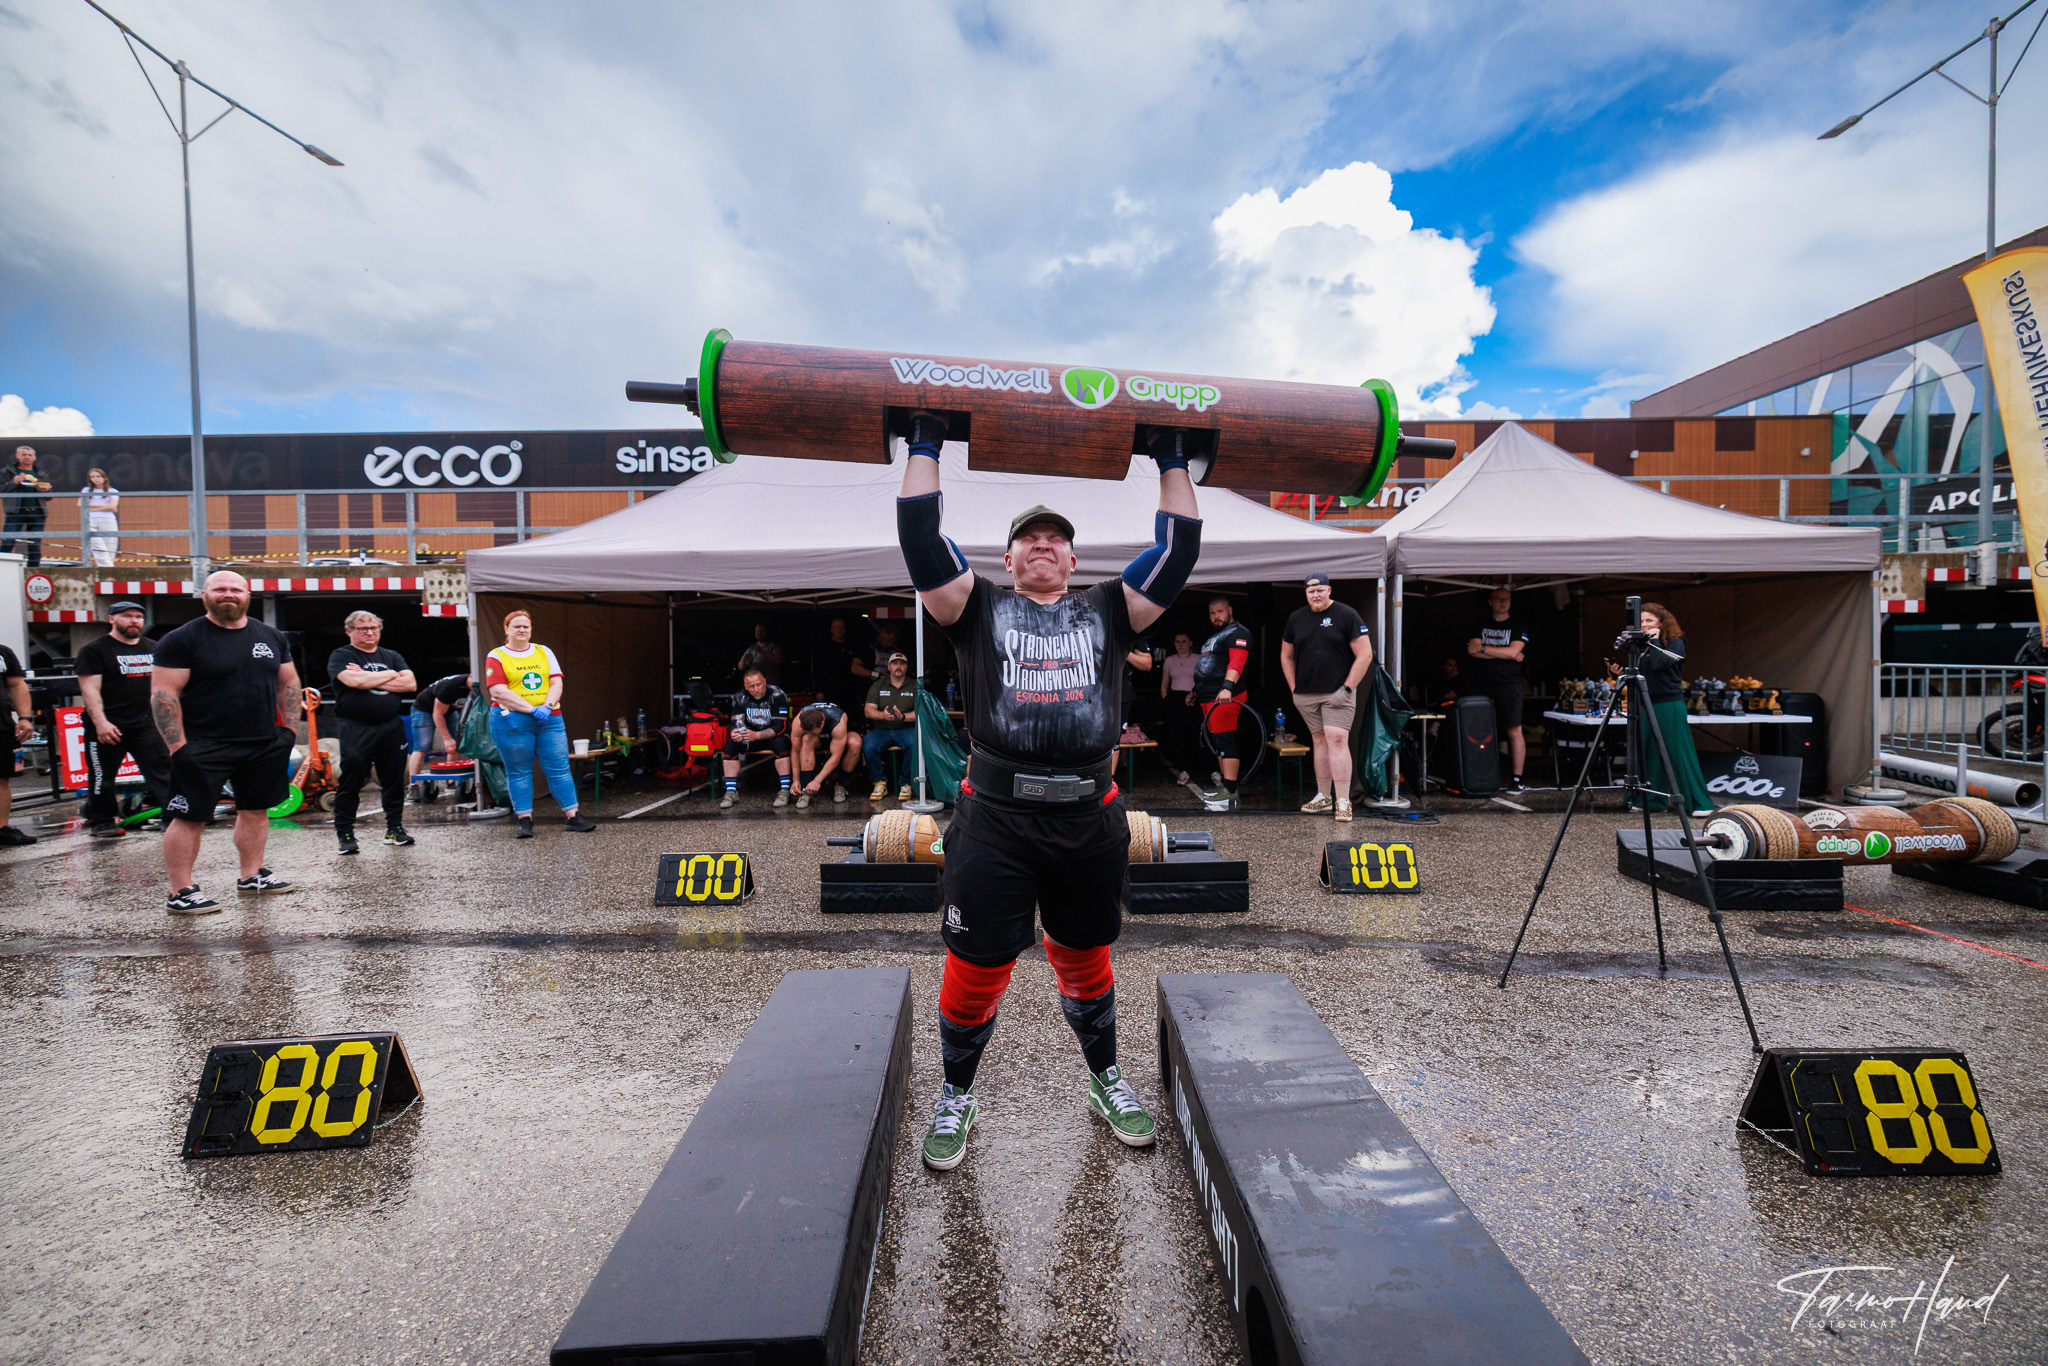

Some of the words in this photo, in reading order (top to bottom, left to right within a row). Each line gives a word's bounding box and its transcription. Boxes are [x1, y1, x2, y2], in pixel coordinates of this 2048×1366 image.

[893, 358, 1048, 390] Woodwell
[1128, 376, 1217, 408] Grupp
[10, 452, 268, 484] erranova
[363, 444, 522, 487] ecco
[616, 440, 718, 473] sinsa
[1003, 628, 1094, 663] STRONGMAN
[1003, 660, 1096, 692] STRONGWOMAN
[1042, 660, 1059, 670] PRO
[1015, 691, 1060, 703] ESTONIA
[1064, 689, 1084, 701] 2026
[1023, 785, 1044, 795] SBD
[1705, 775, 1786, 798] 600€
[1817, 837, 1861, 854] Grupp
[1895, 834, 1966, 853] Woodwell
[675, 853, 744, 902] 100
[1349, 843, 1419, 889] 100
[250, 1040, 379, 1145] 80
[1853, 1058, 1993, 1164] 80
